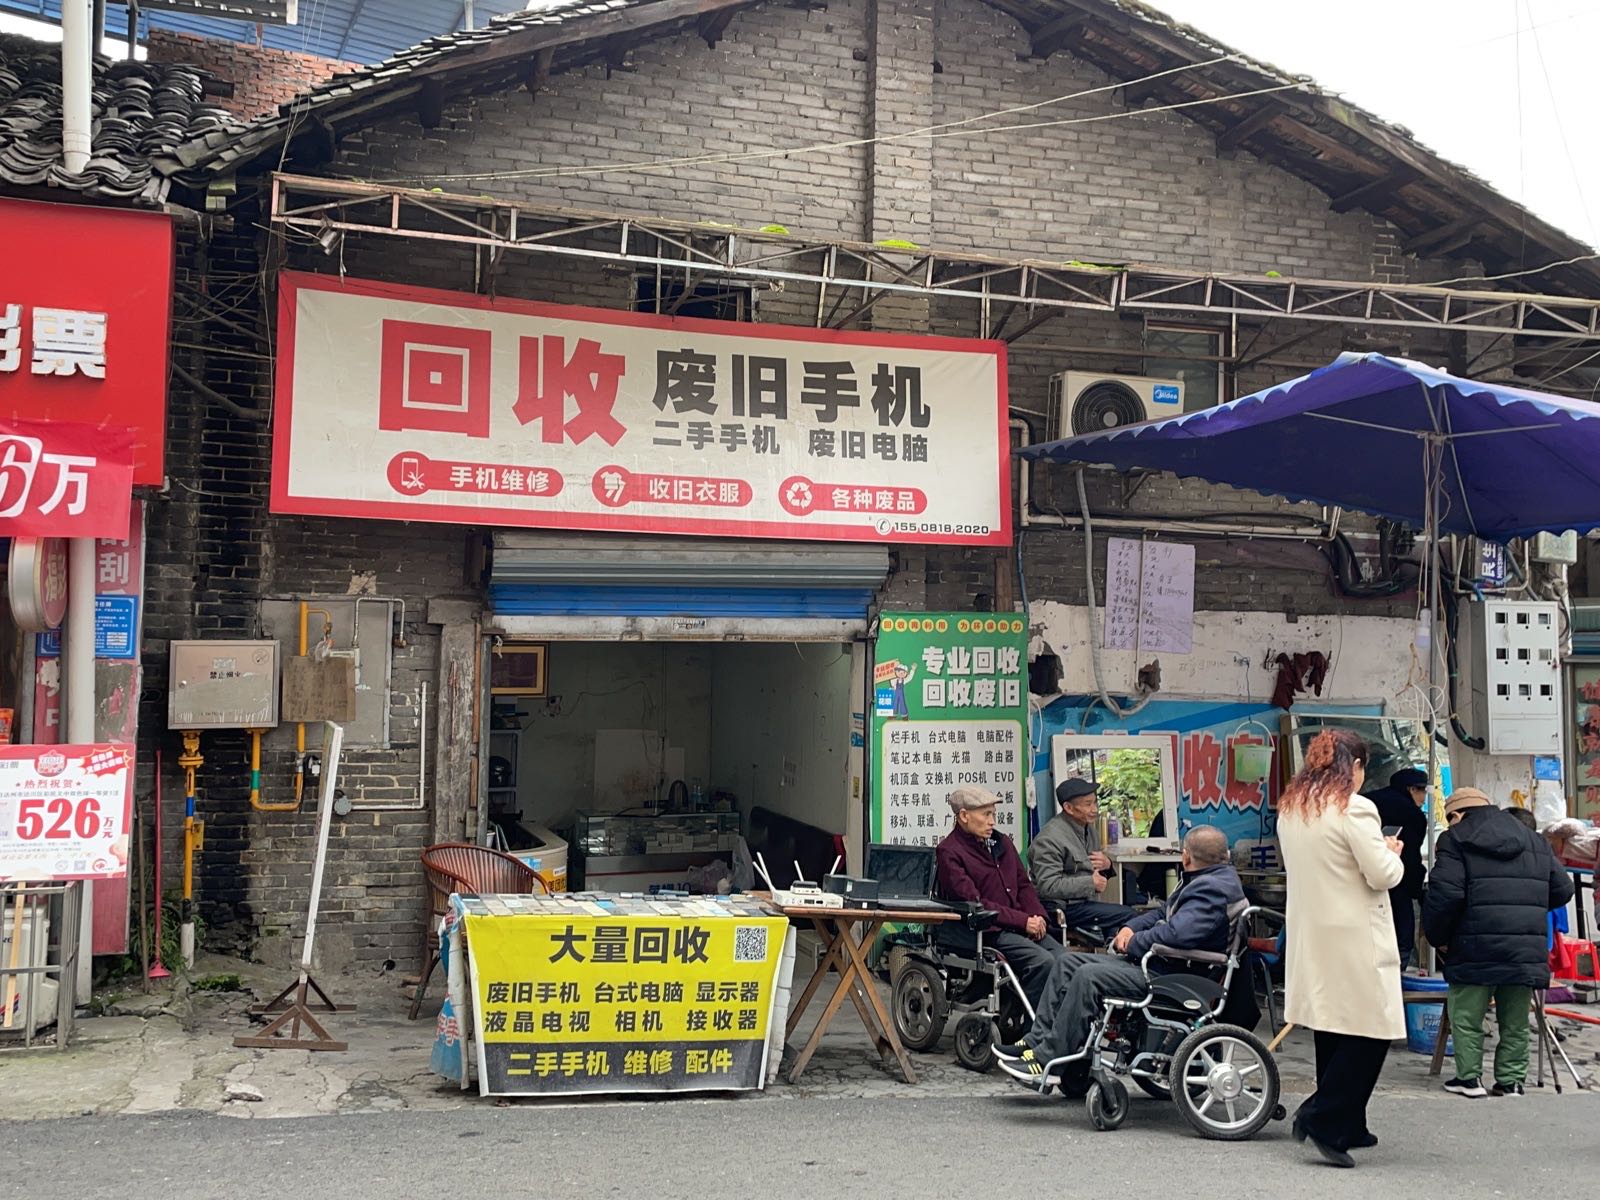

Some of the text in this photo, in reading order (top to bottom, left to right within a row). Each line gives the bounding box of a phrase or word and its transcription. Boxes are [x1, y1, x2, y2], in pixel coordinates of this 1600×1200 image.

[379, 319, 627, 447] 回收
[653, 349, 931, 428] 废旧手机
[653, 420, 928, 463] 二手手机 废旧电脑
[449, 466, 916, 512] 手机维修 收旧衣服 各种废品
[895, 522, 989, 535] 155 0818 2020
[1481, 543, 1497, 577] 民生
[882, 620, 947, 632] 回收再利用
[922, 646, 1020, 675] 专业回收
[923, 679, 1020, 707] 回收废旧
[890, 730, 1014, 744] 烂手机 台式电脑 电脑配件
[890, 750, 1014, 765] 笔记本电脑 光猫 路由器
[24, 779, 74, 789] 热烈祝贺
[890, 771, 1015, 786] 机顶盒 交换机 POS机 EVD
[890, 793, 931, 807] 汽车导航
[17, 798, 101, 840] 526
[102, 816, 115, 839] 万元
[549, 925, 711, 963] 大量回收
[486, 981, 759, 1004] 废旧手机 台式电脑 显示器
[484, 1009, 758, 1033] 液晶电视 相机 接收器
[507, 1048, 734, 1077] 二手手机 维修 配件
